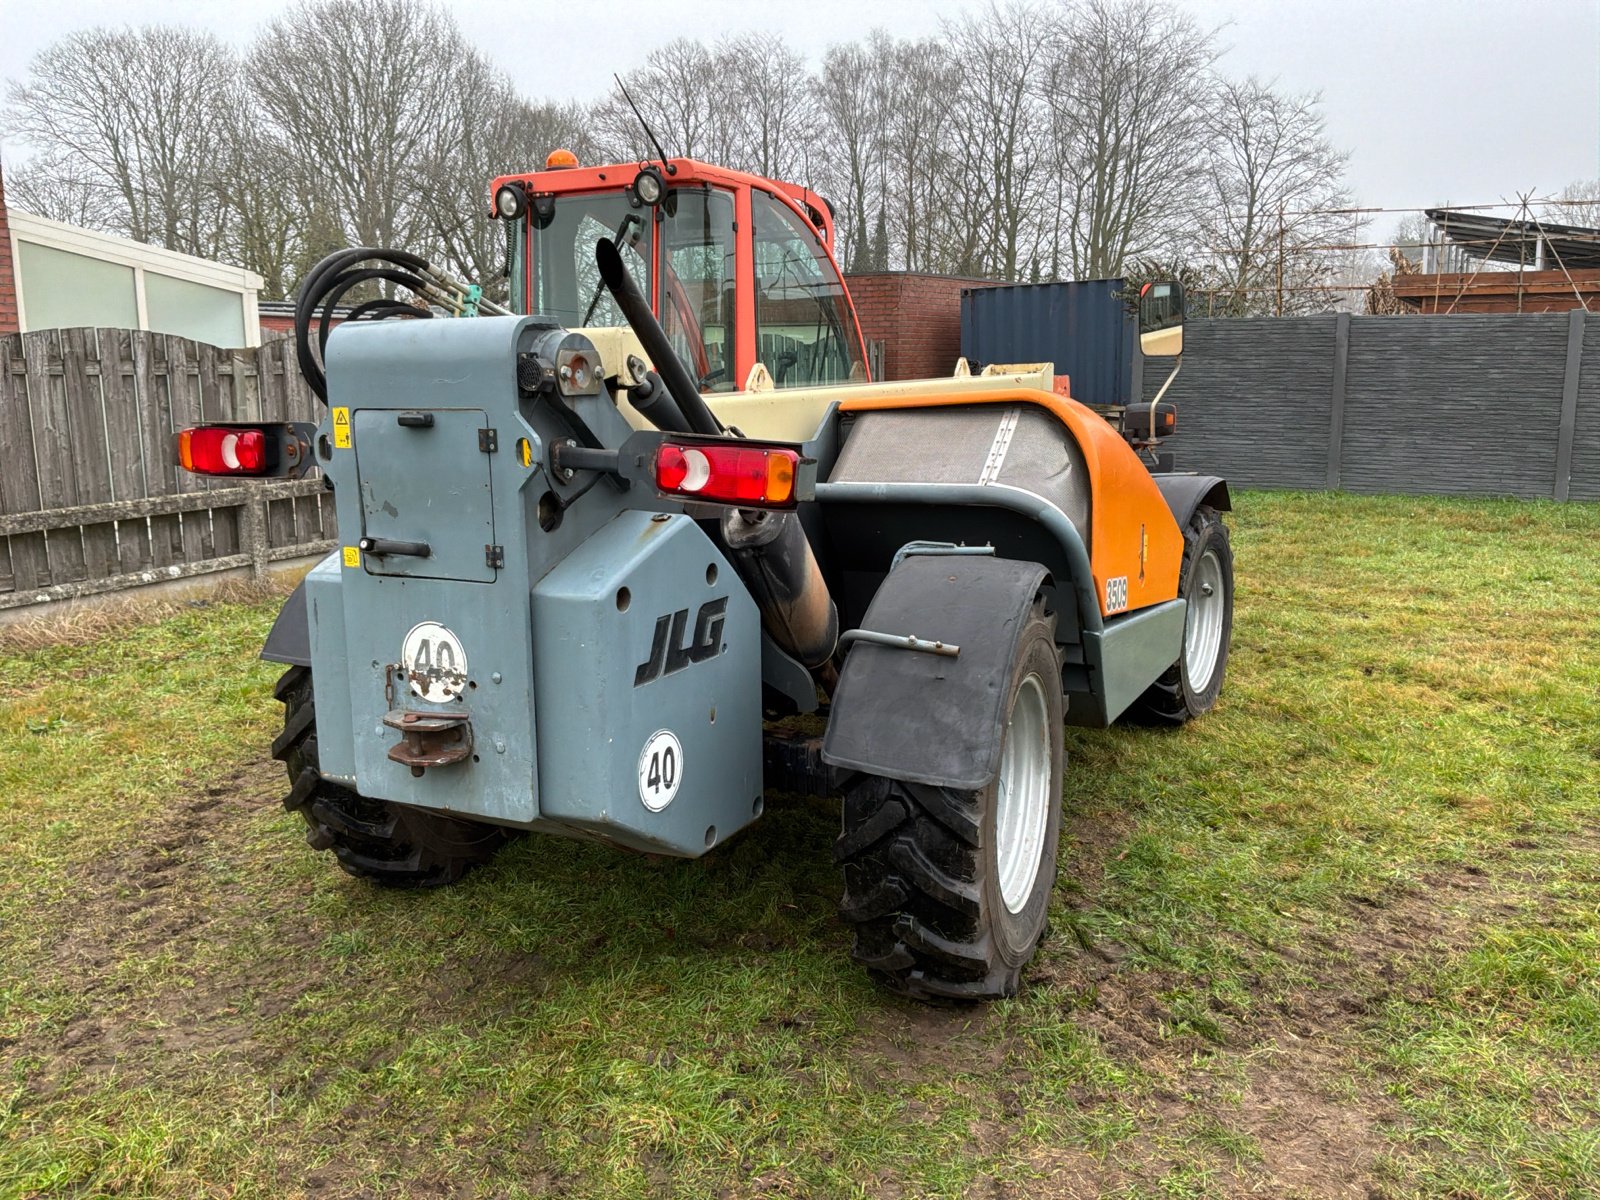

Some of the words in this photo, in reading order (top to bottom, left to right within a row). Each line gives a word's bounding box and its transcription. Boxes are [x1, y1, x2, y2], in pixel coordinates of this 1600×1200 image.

[1106, 578, 1127, 612] 3509
[414, 638, 456, 673] 40
[633, 596, 729, 688] JLG
[647, 746, 676, 794] 40
